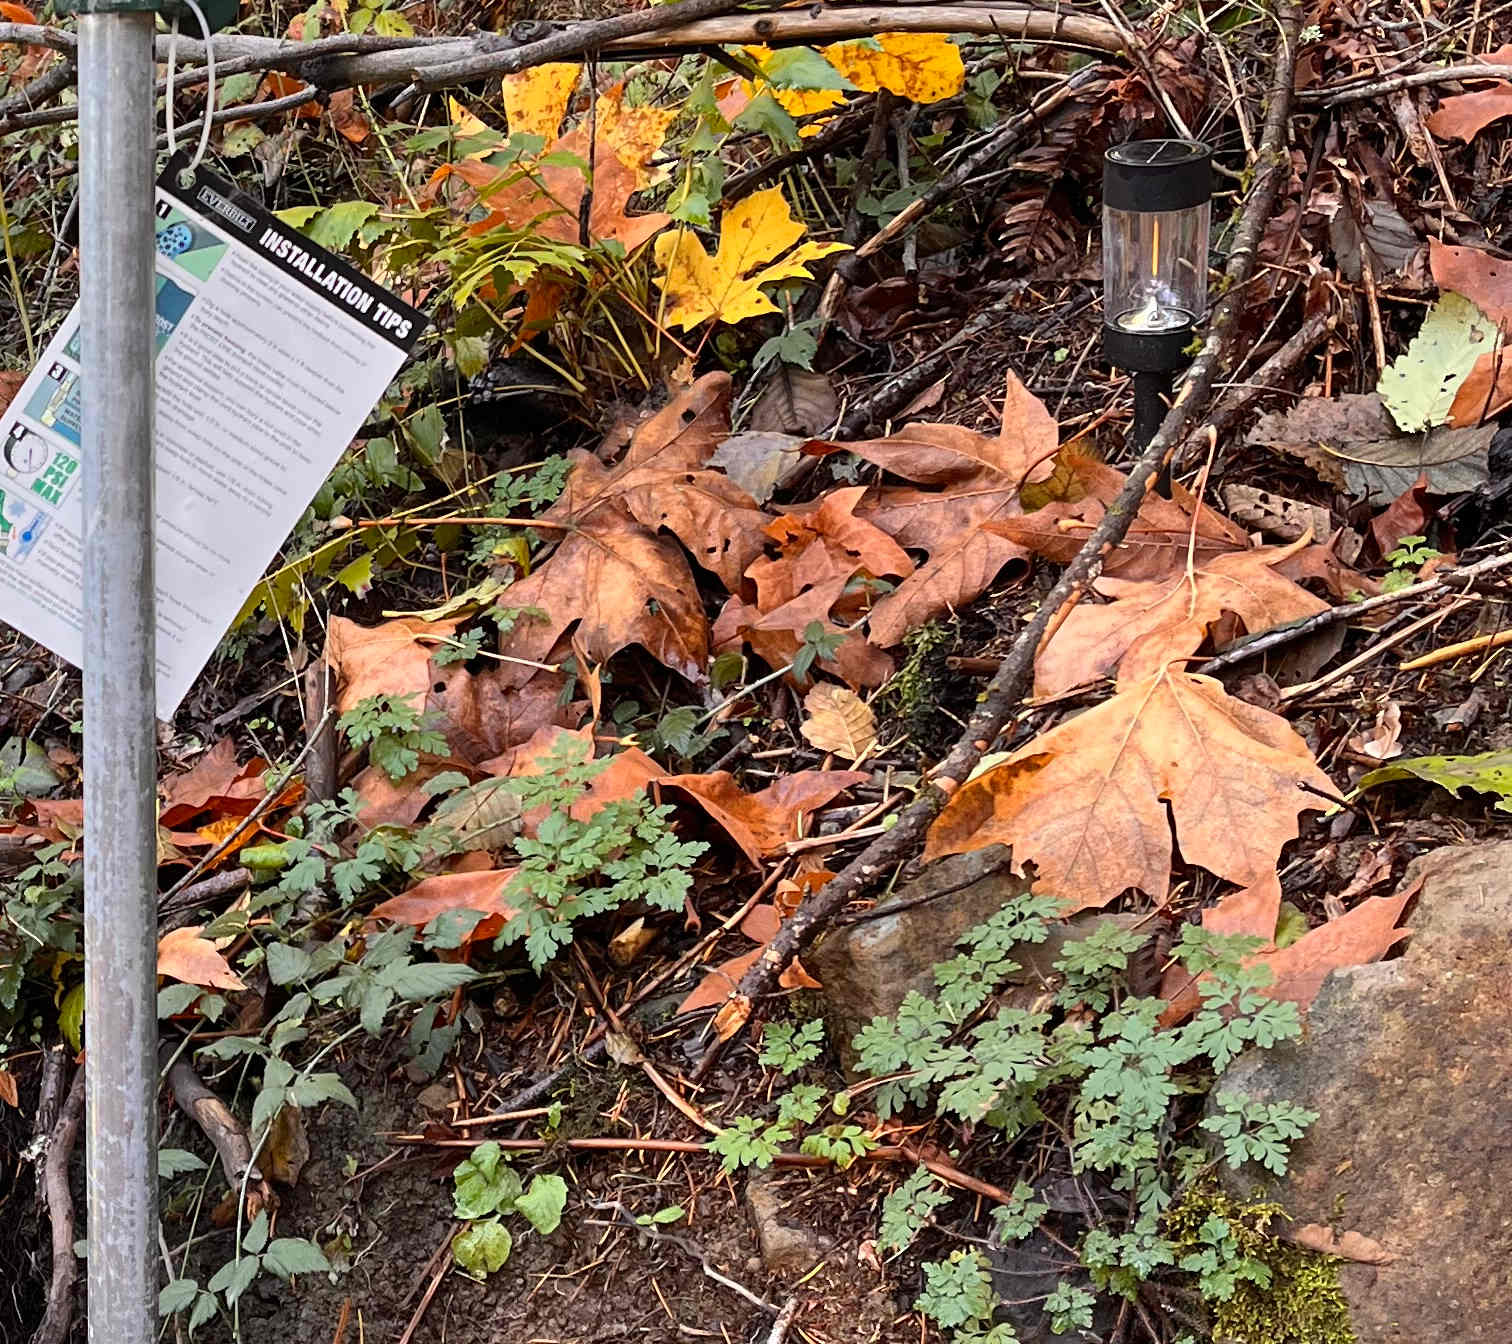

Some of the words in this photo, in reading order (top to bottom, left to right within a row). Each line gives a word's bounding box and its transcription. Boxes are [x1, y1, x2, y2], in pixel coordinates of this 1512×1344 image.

[200, 187, 253, 231] EVERBILT
[258, 227, 376, 314] INSTALLATION
[372, 302, 413, 339] TIPS
[50, 363, 64, 379] 3
[12, 425, 25, 439] 4
[52, 452, 79, 475] 120
[42, 465, 68, 488] PSI
[30, 478, 63, 505] MAX
